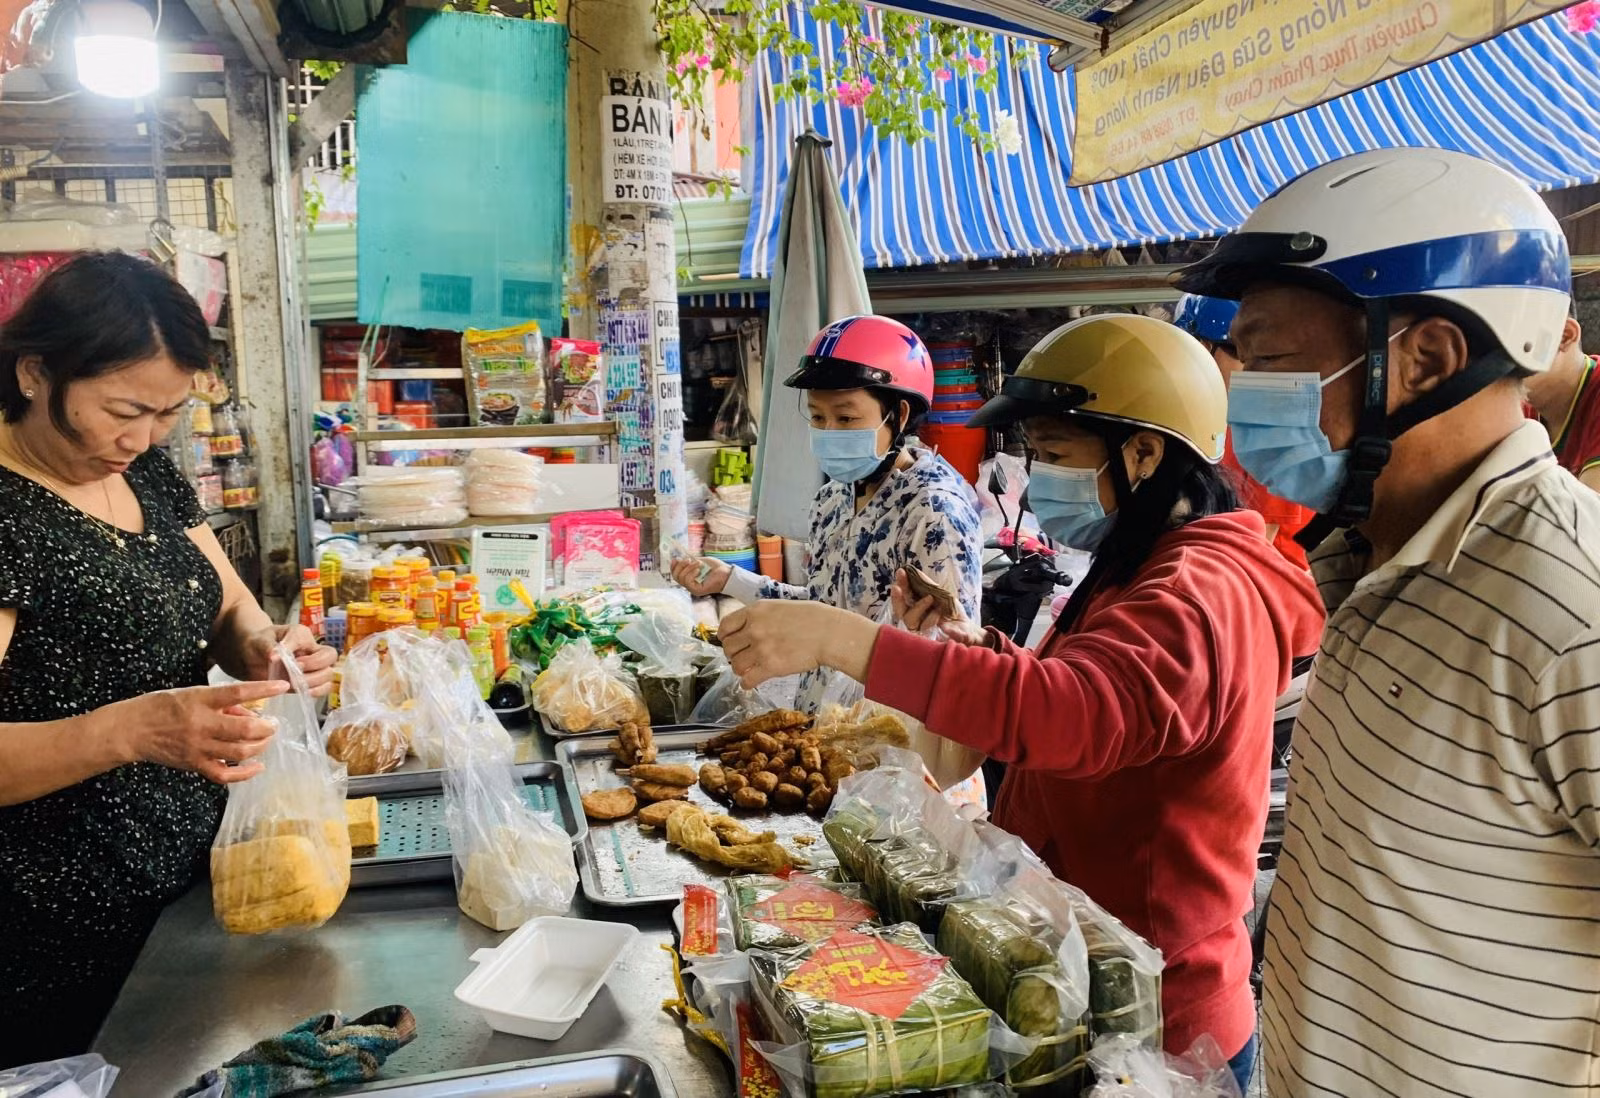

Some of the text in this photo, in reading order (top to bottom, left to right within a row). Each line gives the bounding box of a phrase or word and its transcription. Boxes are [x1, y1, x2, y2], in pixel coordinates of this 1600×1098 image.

[612, 98, 661, 135] BÁN
[615, 184, 638, 199] ĐT:
[660, 382, 676, 399] CHO
